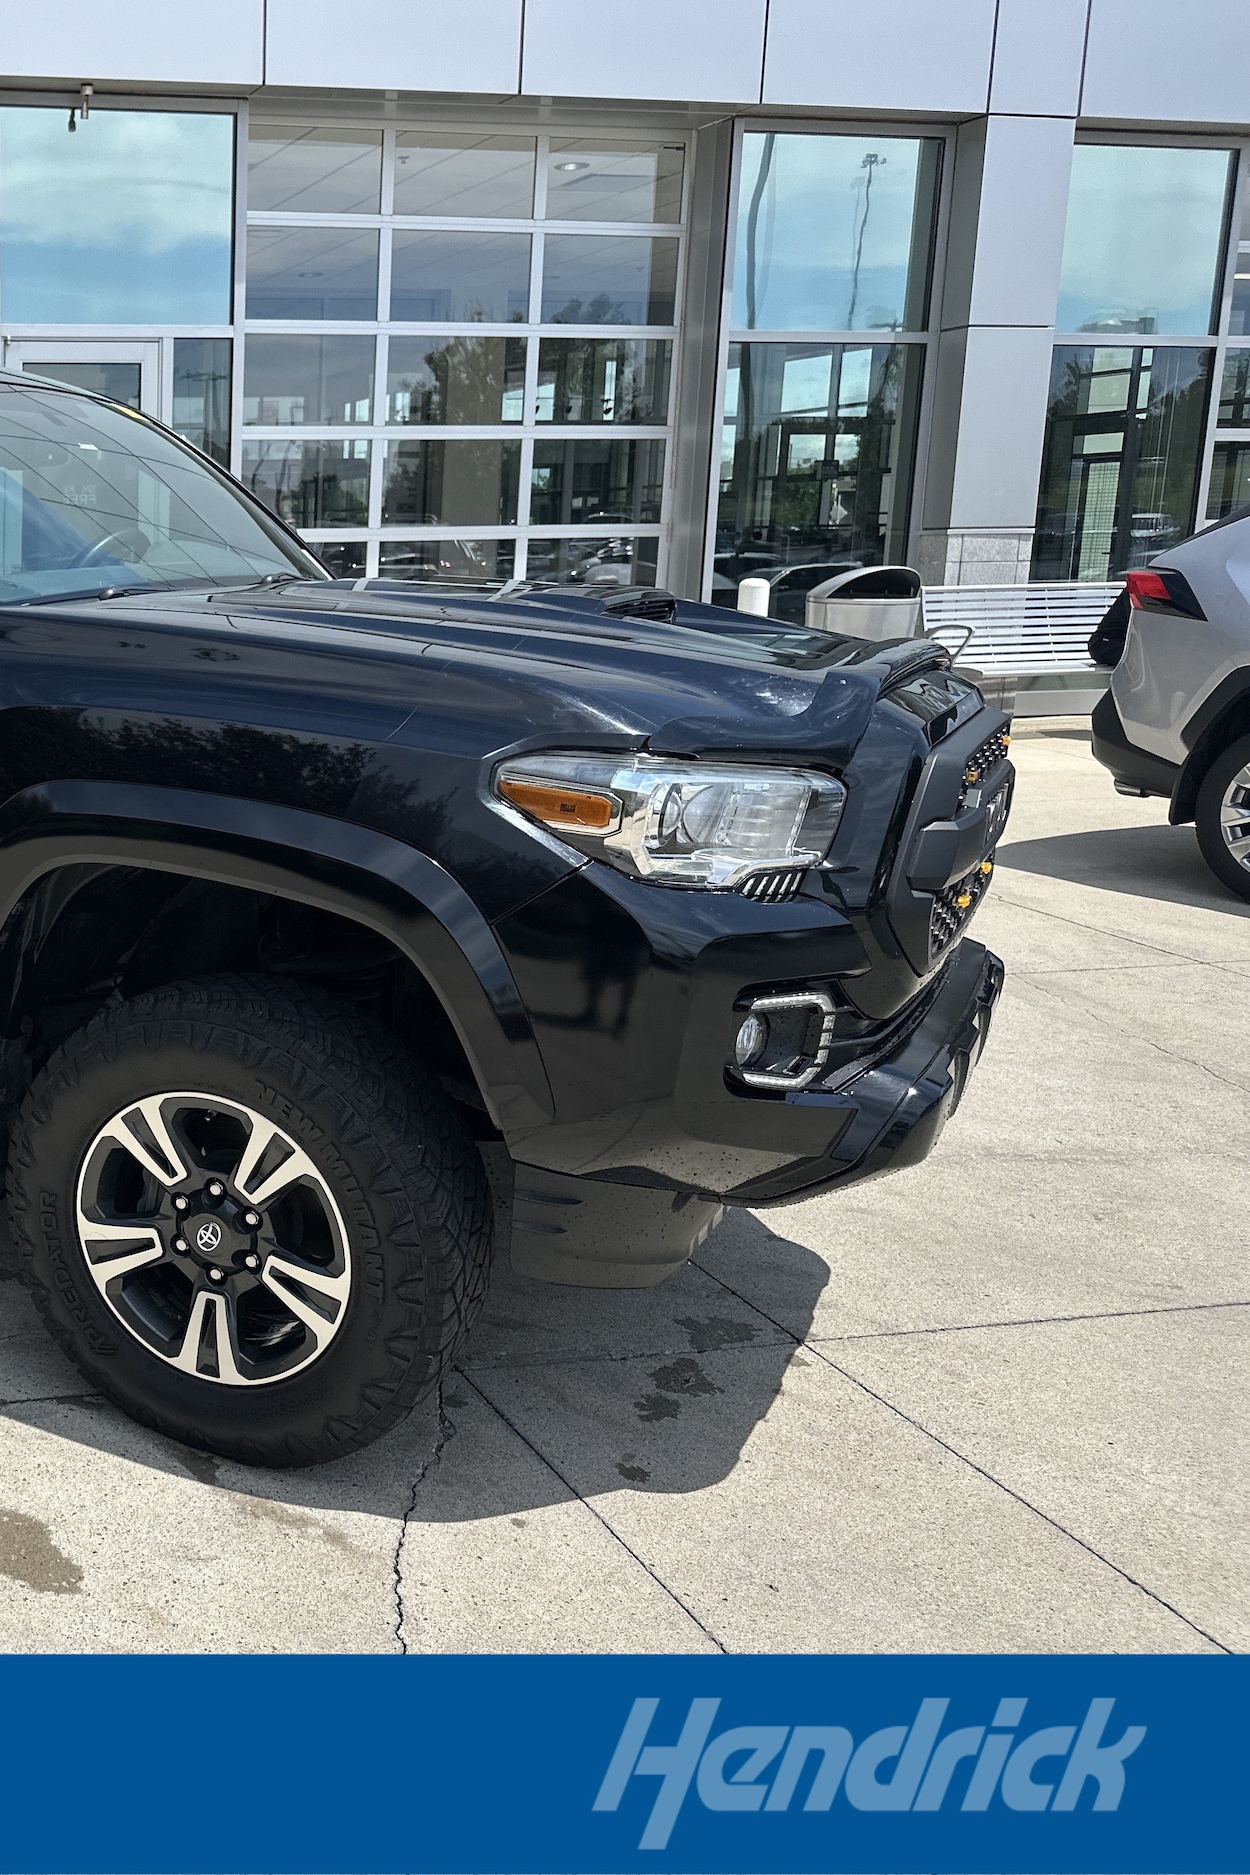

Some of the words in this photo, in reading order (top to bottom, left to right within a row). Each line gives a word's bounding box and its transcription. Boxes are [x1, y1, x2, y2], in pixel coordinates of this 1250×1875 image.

[38, 1189, 112, 1354] PREDATOR
[254, 1077, 326, 1145] NEW
[320, 1139, 387, 1307] MUTANT
